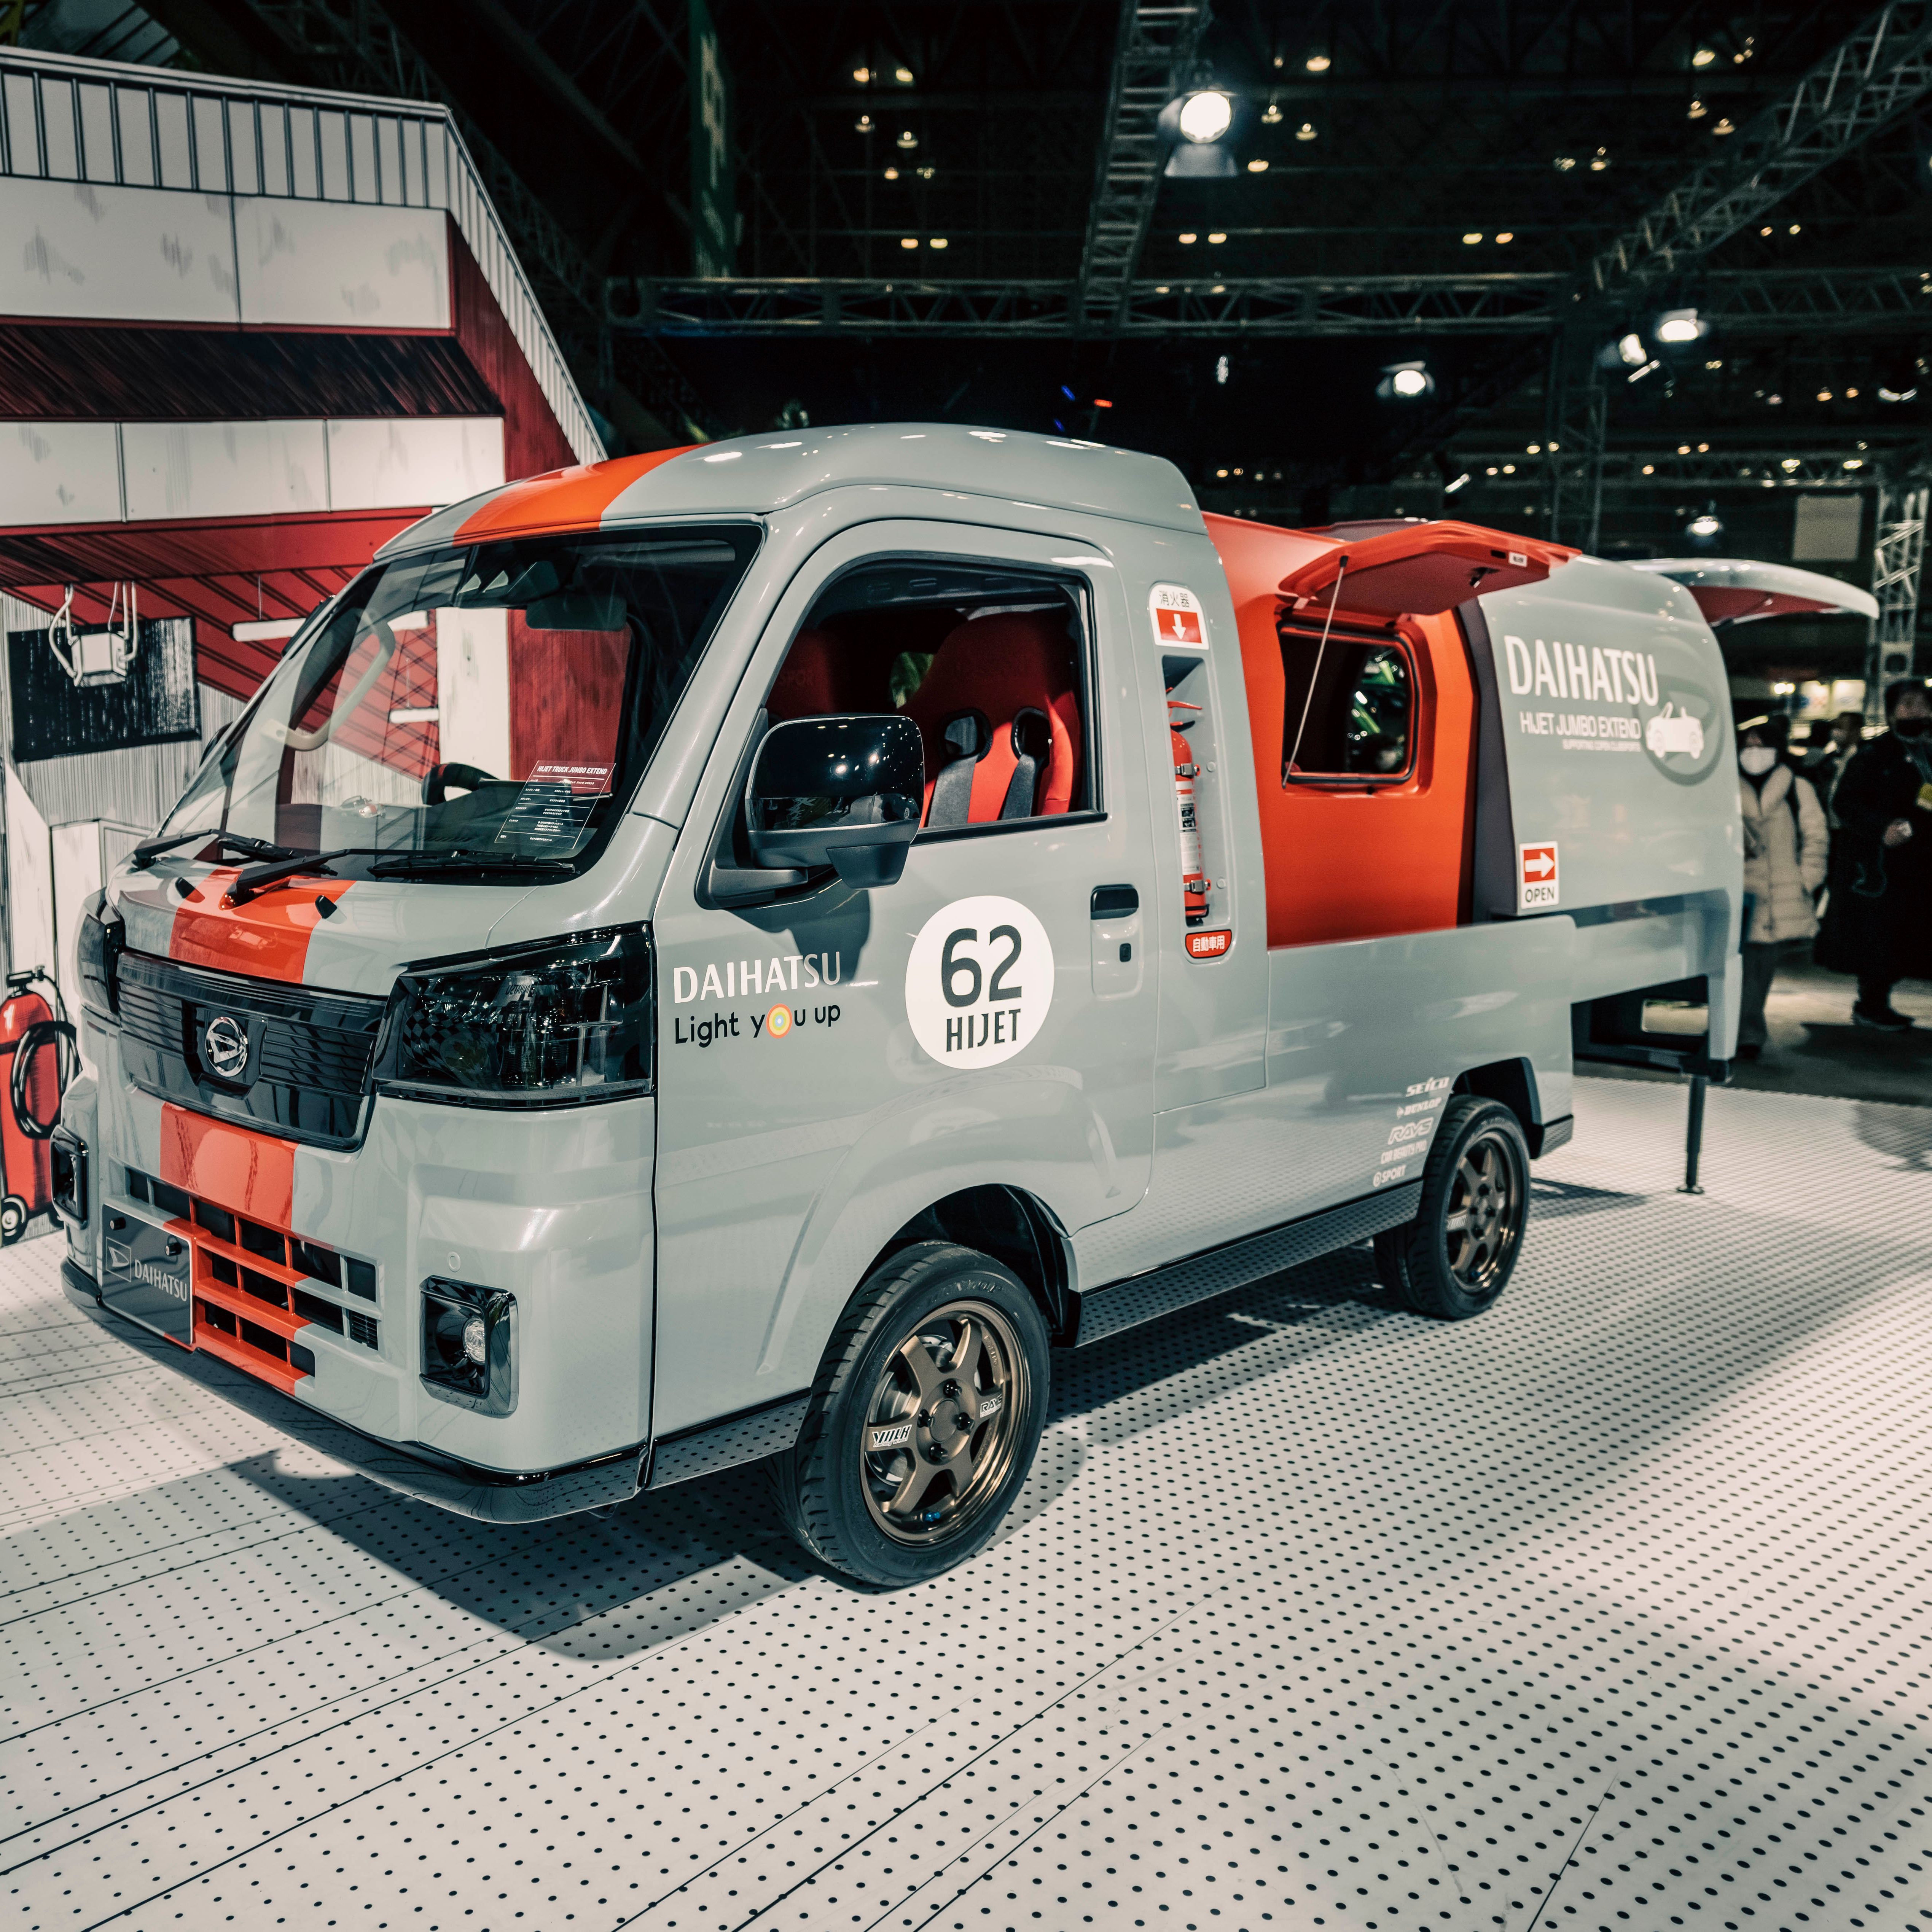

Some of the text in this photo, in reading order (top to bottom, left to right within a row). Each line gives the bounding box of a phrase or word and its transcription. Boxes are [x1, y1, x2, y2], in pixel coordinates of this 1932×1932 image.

[1159, 590, 1189, 608] 消火器
[1504, 635, 1659, 706] DAIHATSU
[1519, 711, 1642, 739] HIJET JUMBO EXTEND
[1525, 886, 1555, 902] OPEN
[1193, 935, 1225, 952] 自動車用
[673, 951, 841, 1003] DAIHATSU
[941, 925, 1023, 1007] 62
[675, 1011, 740, 1048] Light
[814, 1003, 841, 1027] up
[946, 1008, 1021, 1053] HIJET
[1404, 1097, 1441, 1116] DUNLOP
[1388, 1117, 1433, 1145] RAYS
[1381, 1164, 1406, 1183] SPORT
[134, 1259, 187, 1301] DAIHATSU
[873, 1424, 912, 1443] VOLK
